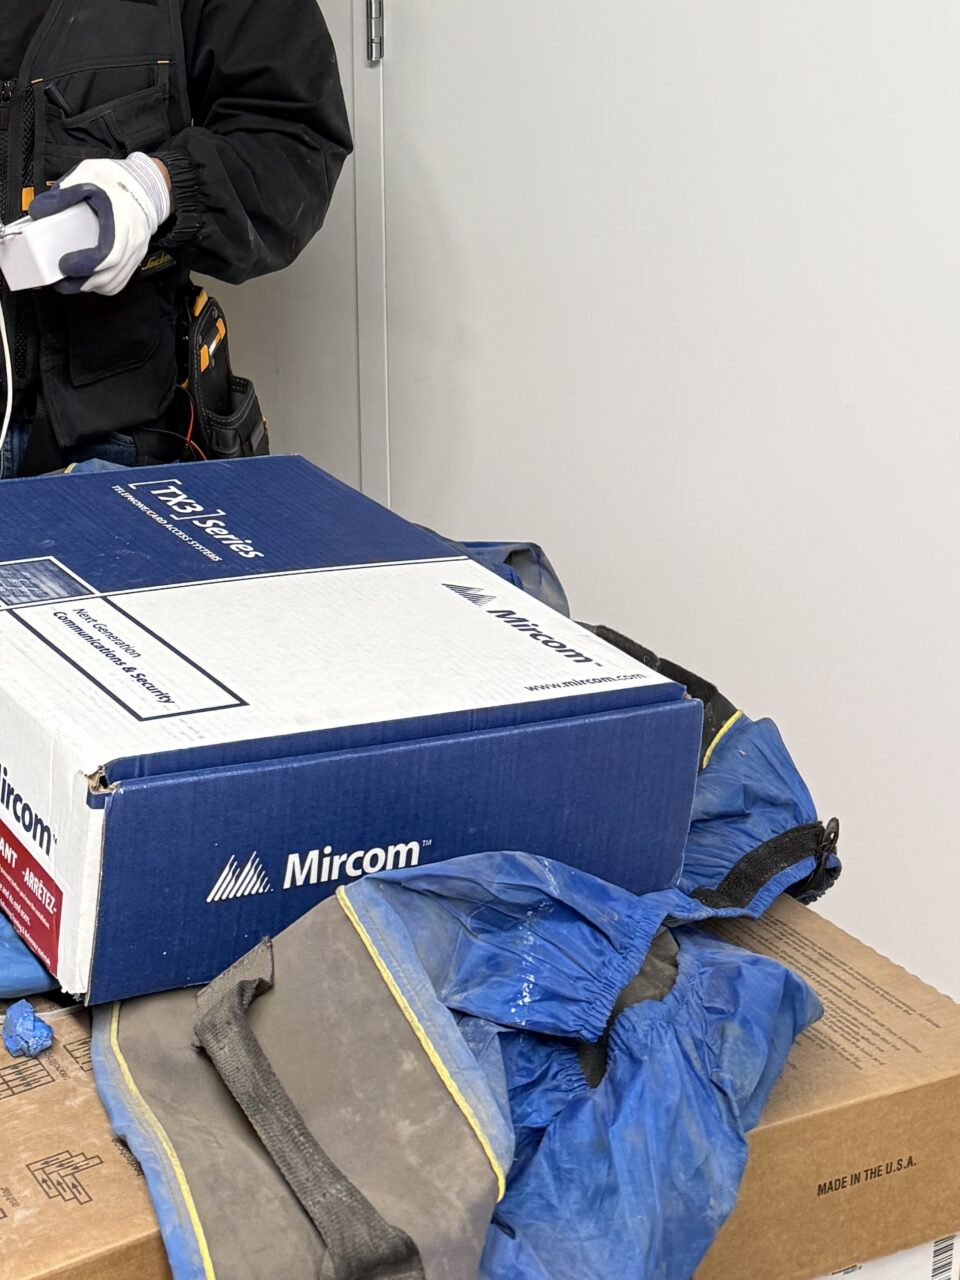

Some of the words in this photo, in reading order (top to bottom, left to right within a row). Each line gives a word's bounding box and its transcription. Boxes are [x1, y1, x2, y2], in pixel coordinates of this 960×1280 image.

[164, 523, 192, 545] ACCESS
[187, 539, 223, 562] SYSTEMS
[193, 519, 265, 558] Series
[72, 608, 98, 624] Next
[92, 623, 141, 659] Generation
[486, 609, 593, 663] Mircom
[53, 611, 127, 666] Communications
[130, 673, 176, 704] Security
[525, 672, 648, 692] www.mircom.com
[282, 841, 420, 890] Mircom
[817, 1176, 848, 1196] MADE
[850, 1172, 861, 1186] IN
[864, 1164, 883, 1183] THE
[885, 1155, 917, 1175] U.S.A.
